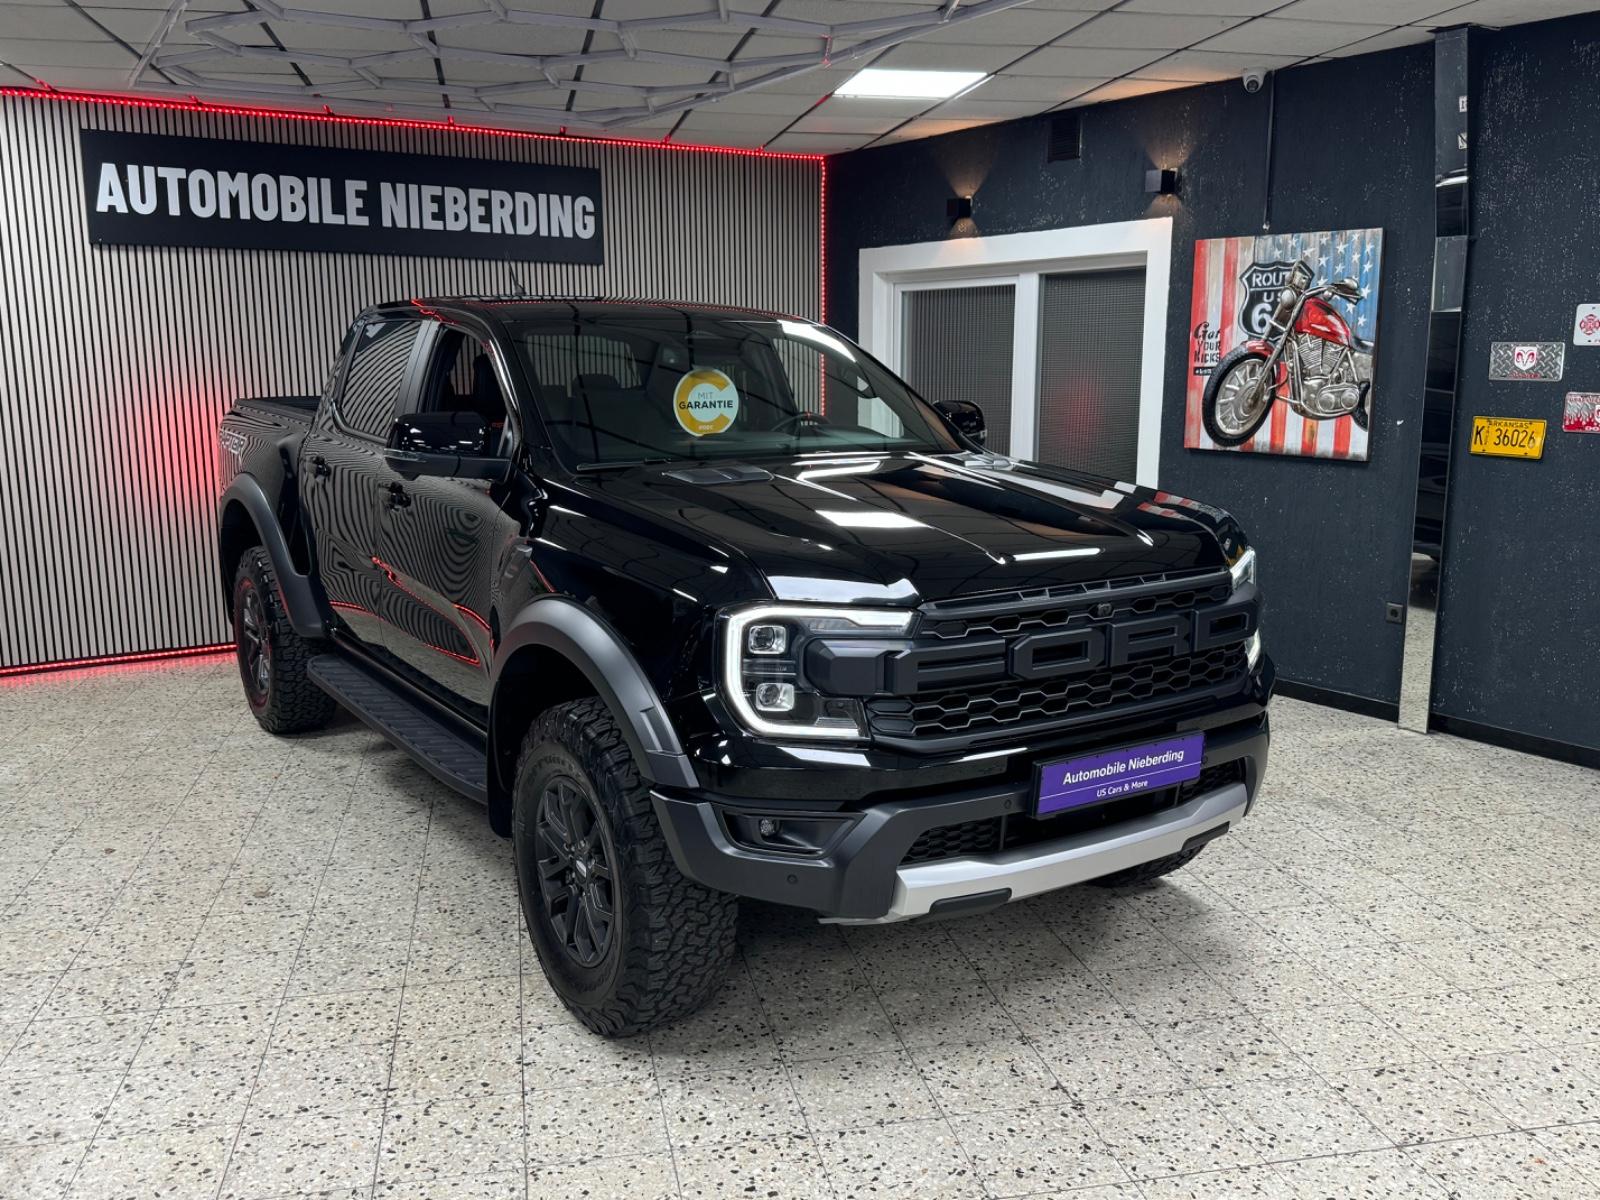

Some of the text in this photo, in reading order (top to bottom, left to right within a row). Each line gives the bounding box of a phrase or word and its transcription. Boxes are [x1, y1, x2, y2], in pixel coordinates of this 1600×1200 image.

[95, 162, 596, 240] AUTOMOBILE NIEBERDING
[679, 400, 734, 410] GARANTIE
[697, 391, 713, 400] MIT
[1488, 419, 1529, 429] ARKANSAS
[1473, 425, 1485, 445] K
[1493, 428, 1535, 449] 36026
[888, 600, 1258, 696] FORD
[1063, 750, 1184, 784] Automobile Nieberding
[1096, 780, 1148, 798] US Cars & More
